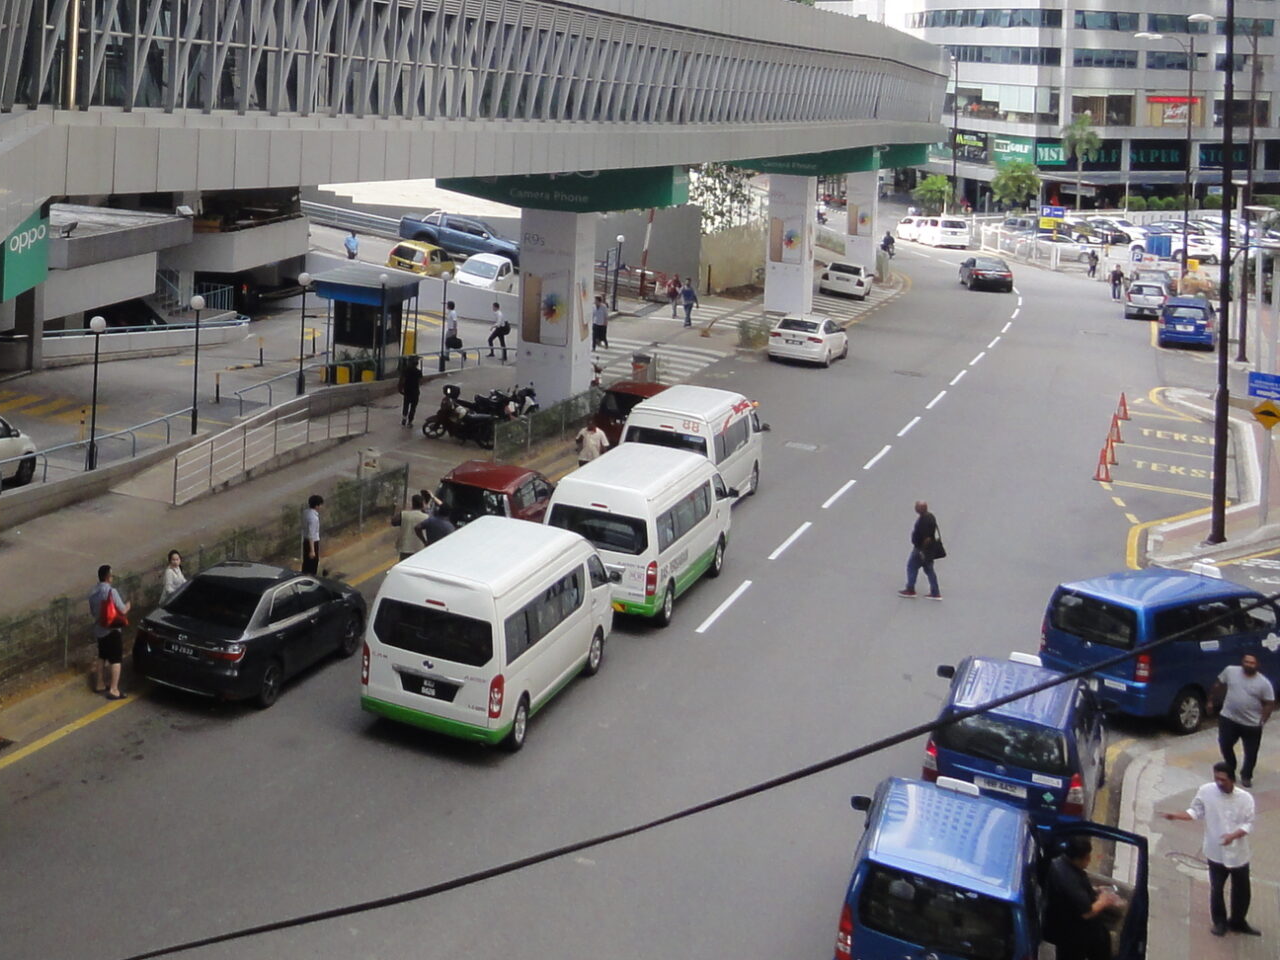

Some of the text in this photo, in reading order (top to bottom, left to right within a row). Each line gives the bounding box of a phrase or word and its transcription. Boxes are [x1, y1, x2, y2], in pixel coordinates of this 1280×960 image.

[1037, 147, 1065, 162] MST
[509, 188, 589, 203] Camera Phone
[10, 224, 46, 254] oppo
